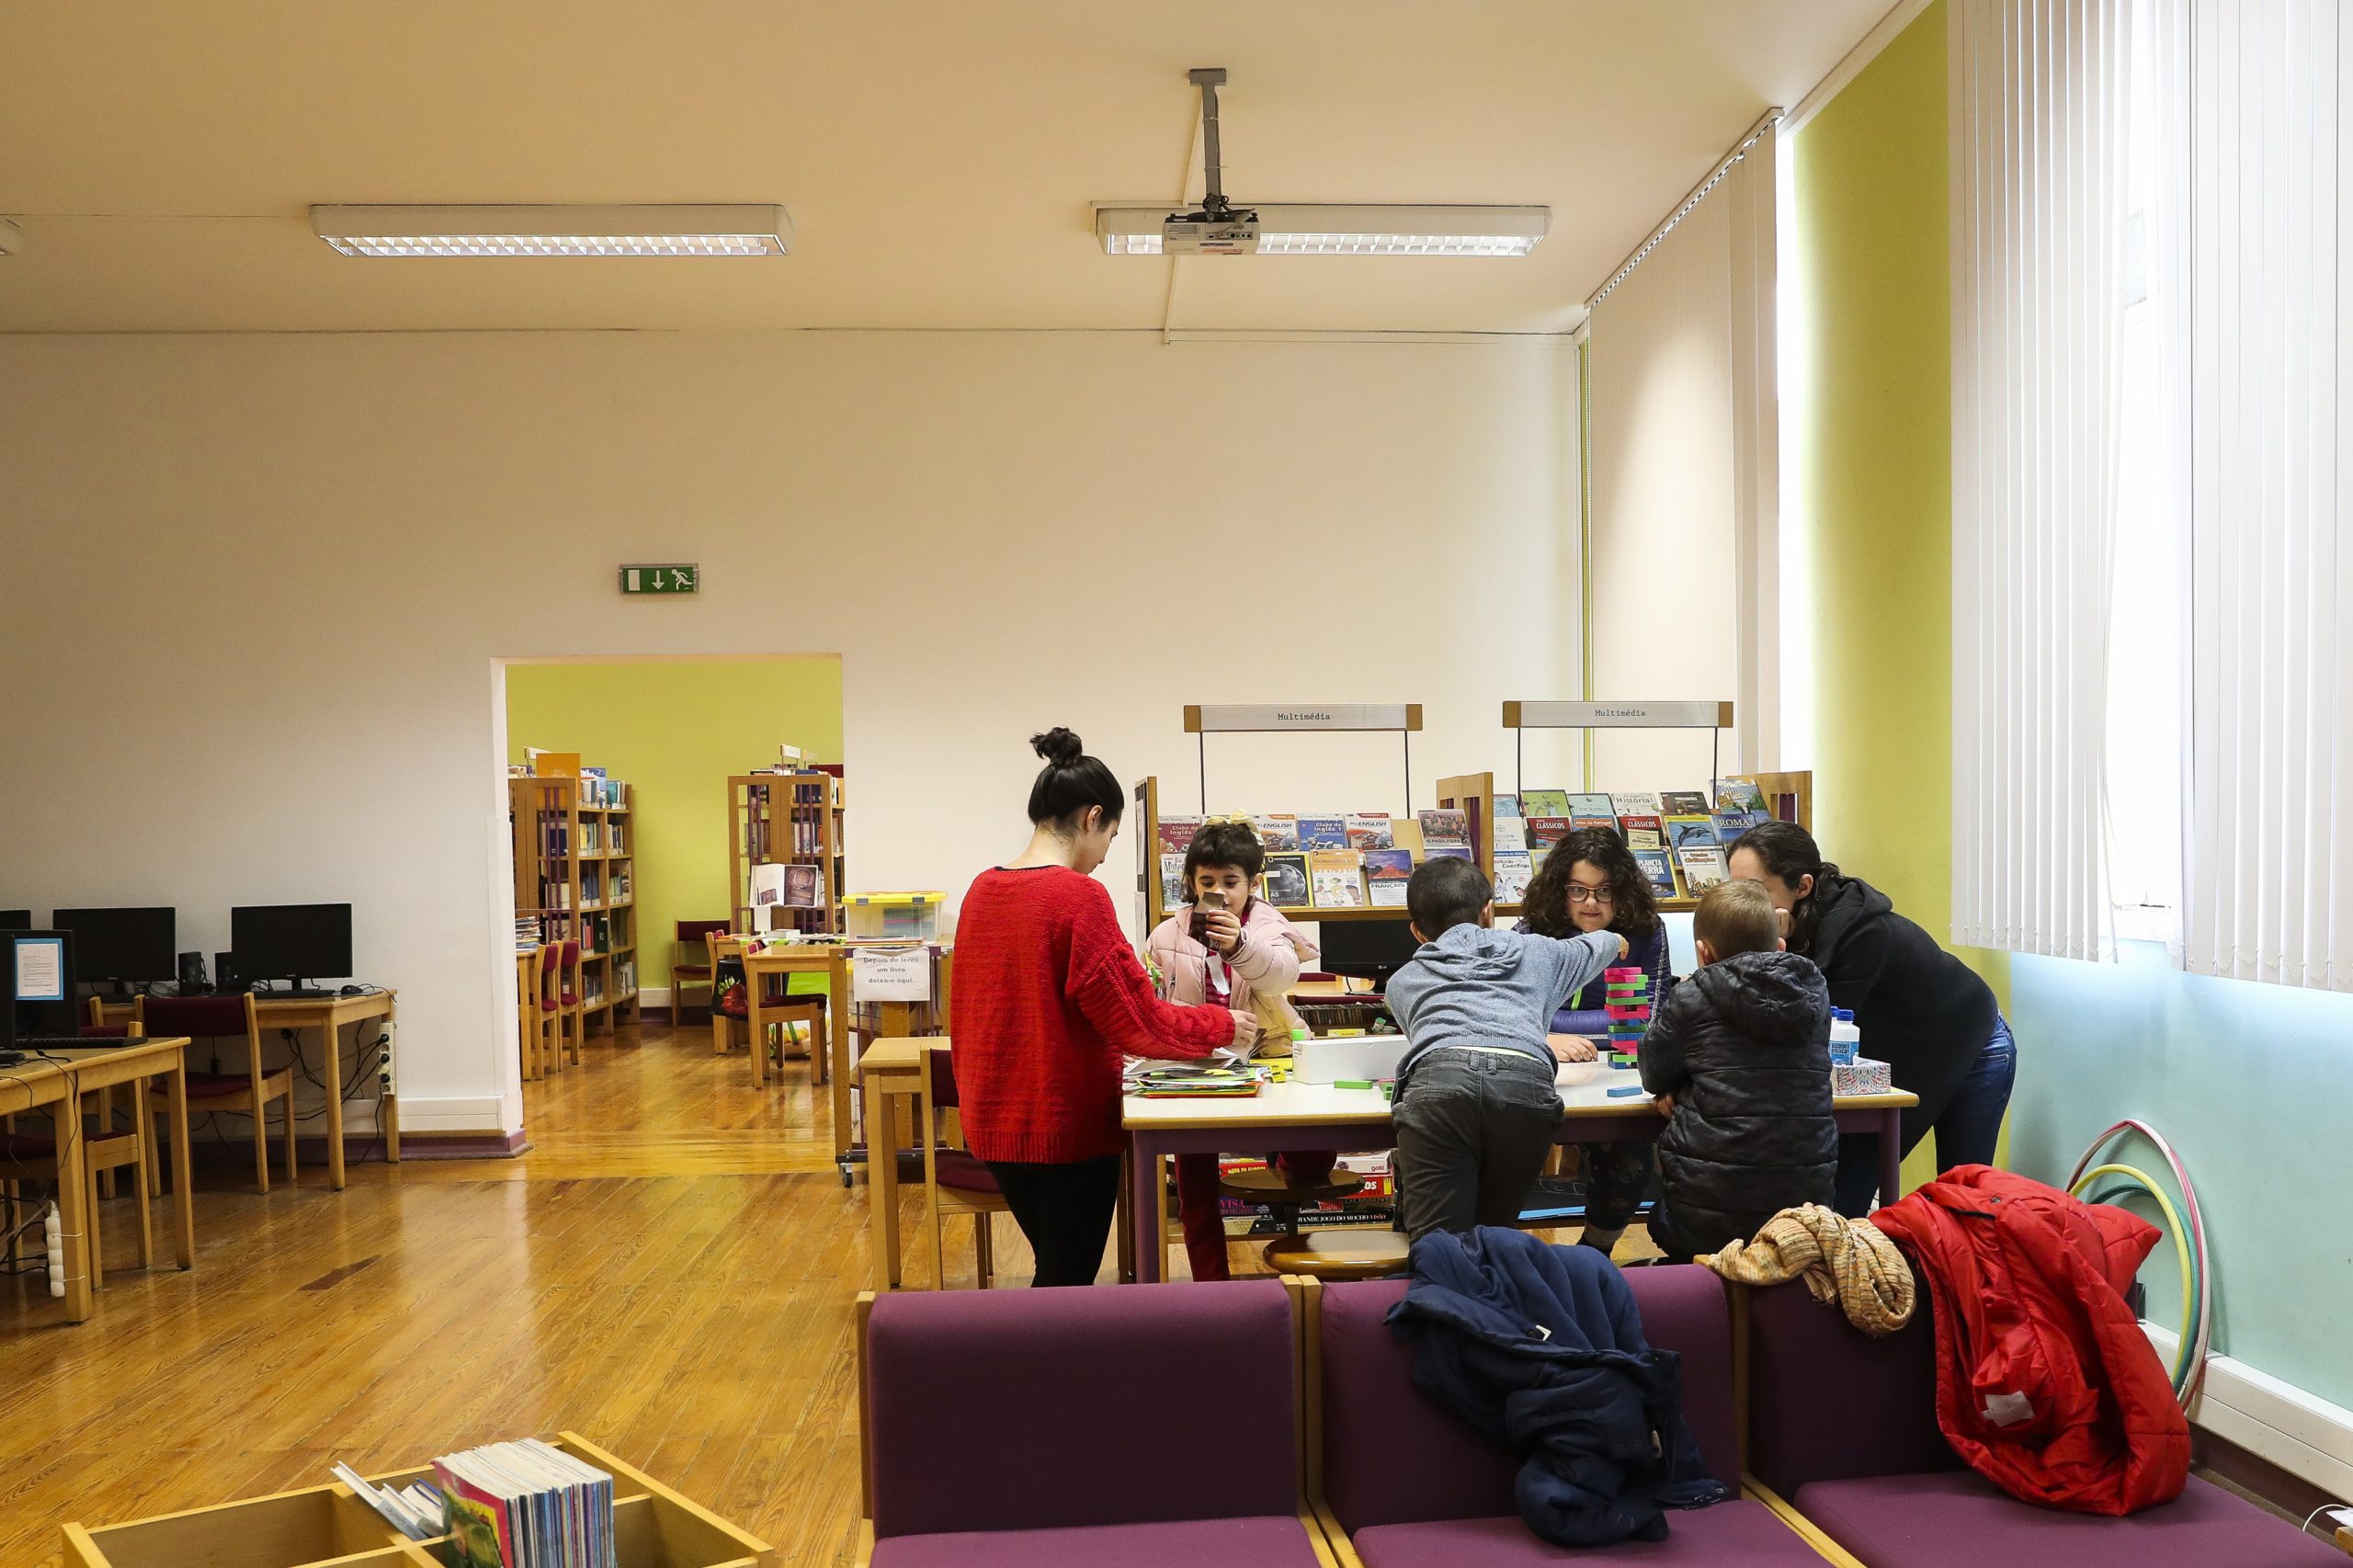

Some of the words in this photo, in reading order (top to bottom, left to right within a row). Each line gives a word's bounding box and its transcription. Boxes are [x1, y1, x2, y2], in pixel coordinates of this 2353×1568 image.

[1278, 712, 1331, 721] Multimédia
[1595, 709, 1646, 717] Multimédia
[1719, 819, 1751, 827] ROMA
[1637, 858, 1663, 867] PLANETA
